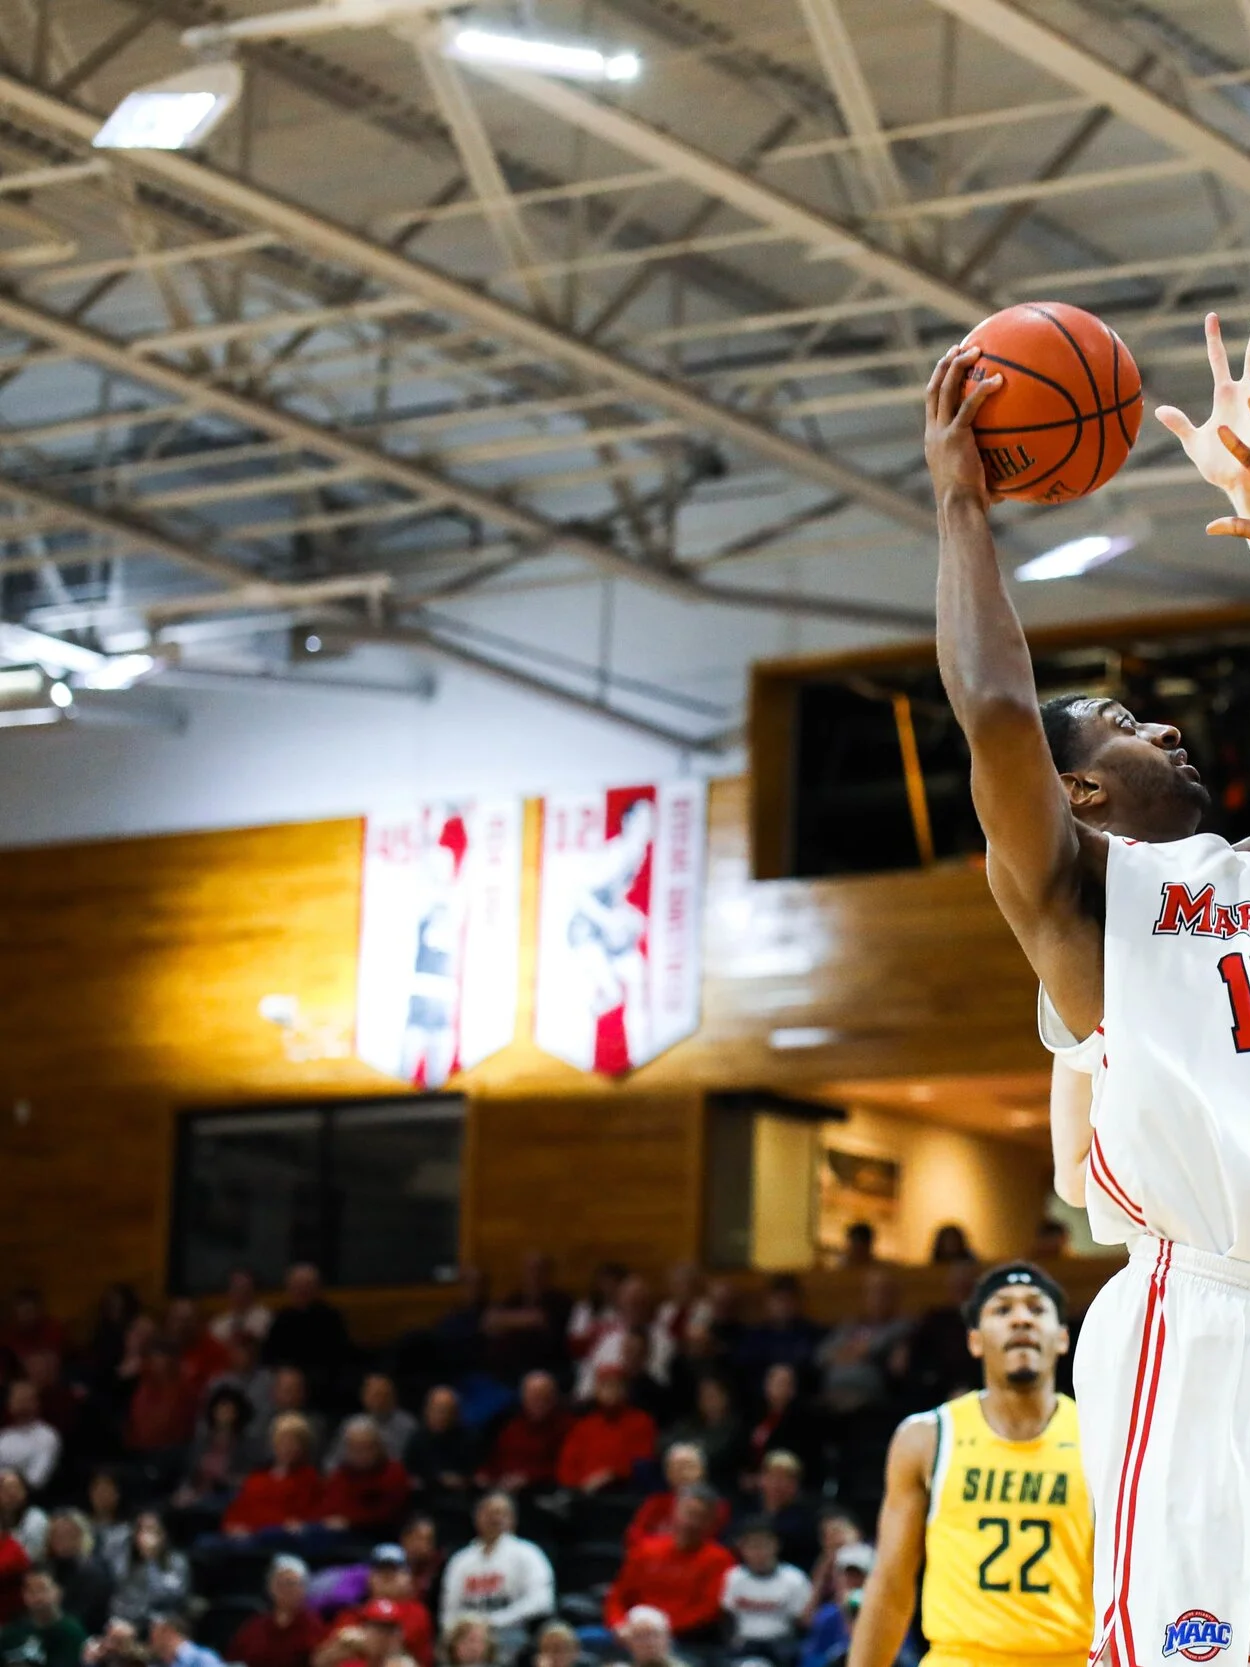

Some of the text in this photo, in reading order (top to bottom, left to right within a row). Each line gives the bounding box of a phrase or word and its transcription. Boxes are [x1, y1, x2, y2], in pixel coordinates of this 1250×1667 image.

[962, 1468, 1068, 1506] SIENA
[978, 1517, 1052, 1593] 22
[1162, 1621, 1233, 1658] MAAC
